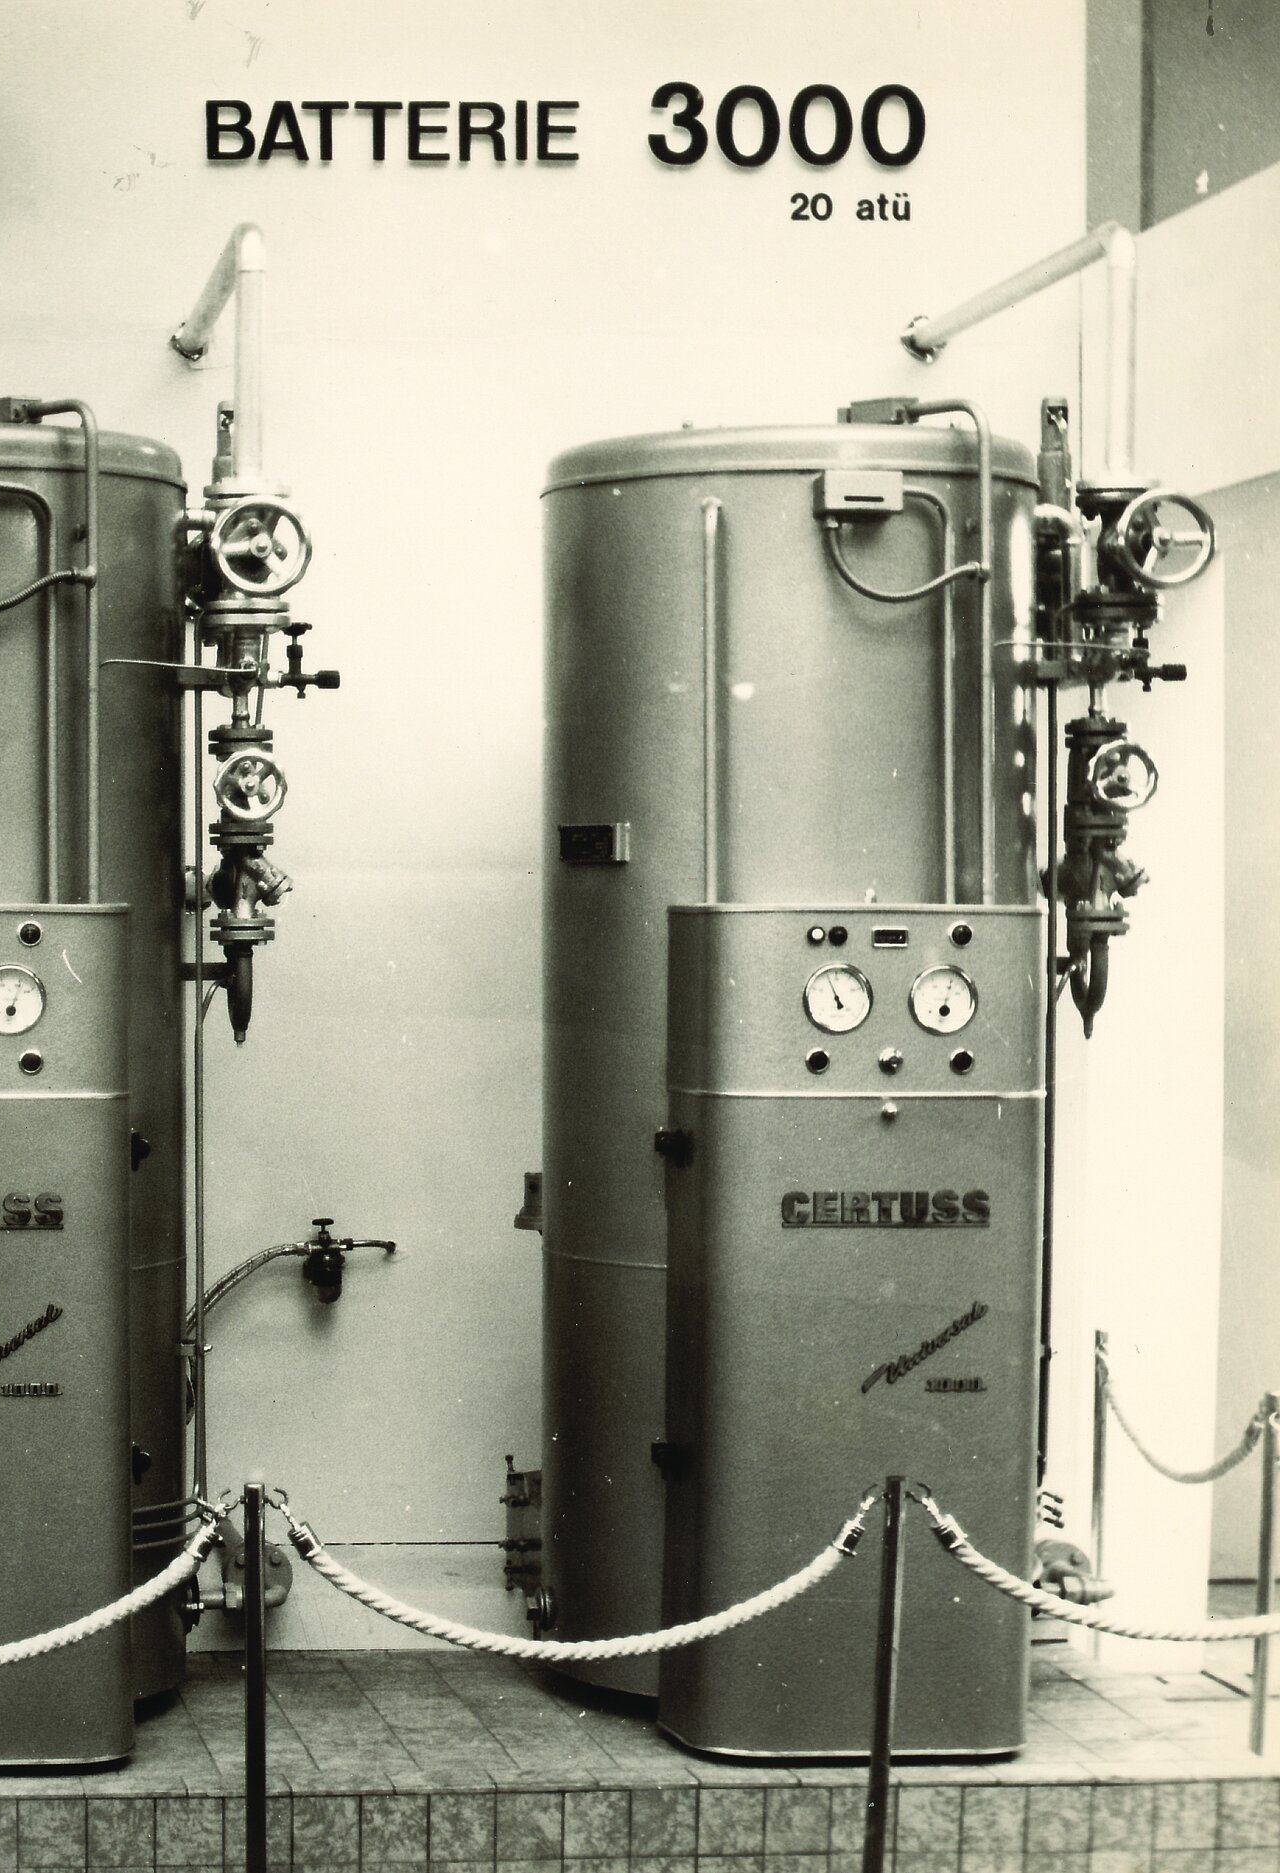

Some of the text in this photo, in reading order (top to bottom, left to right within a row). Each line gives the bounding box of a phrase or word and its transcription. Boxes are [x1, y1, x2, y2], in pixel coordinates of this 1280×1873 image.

[205, 81, 926, 167] BATTERIE 3000
[789, 192, 911, 221] 20 atü
[781, 1189, 991, 1225] CERTUSS
